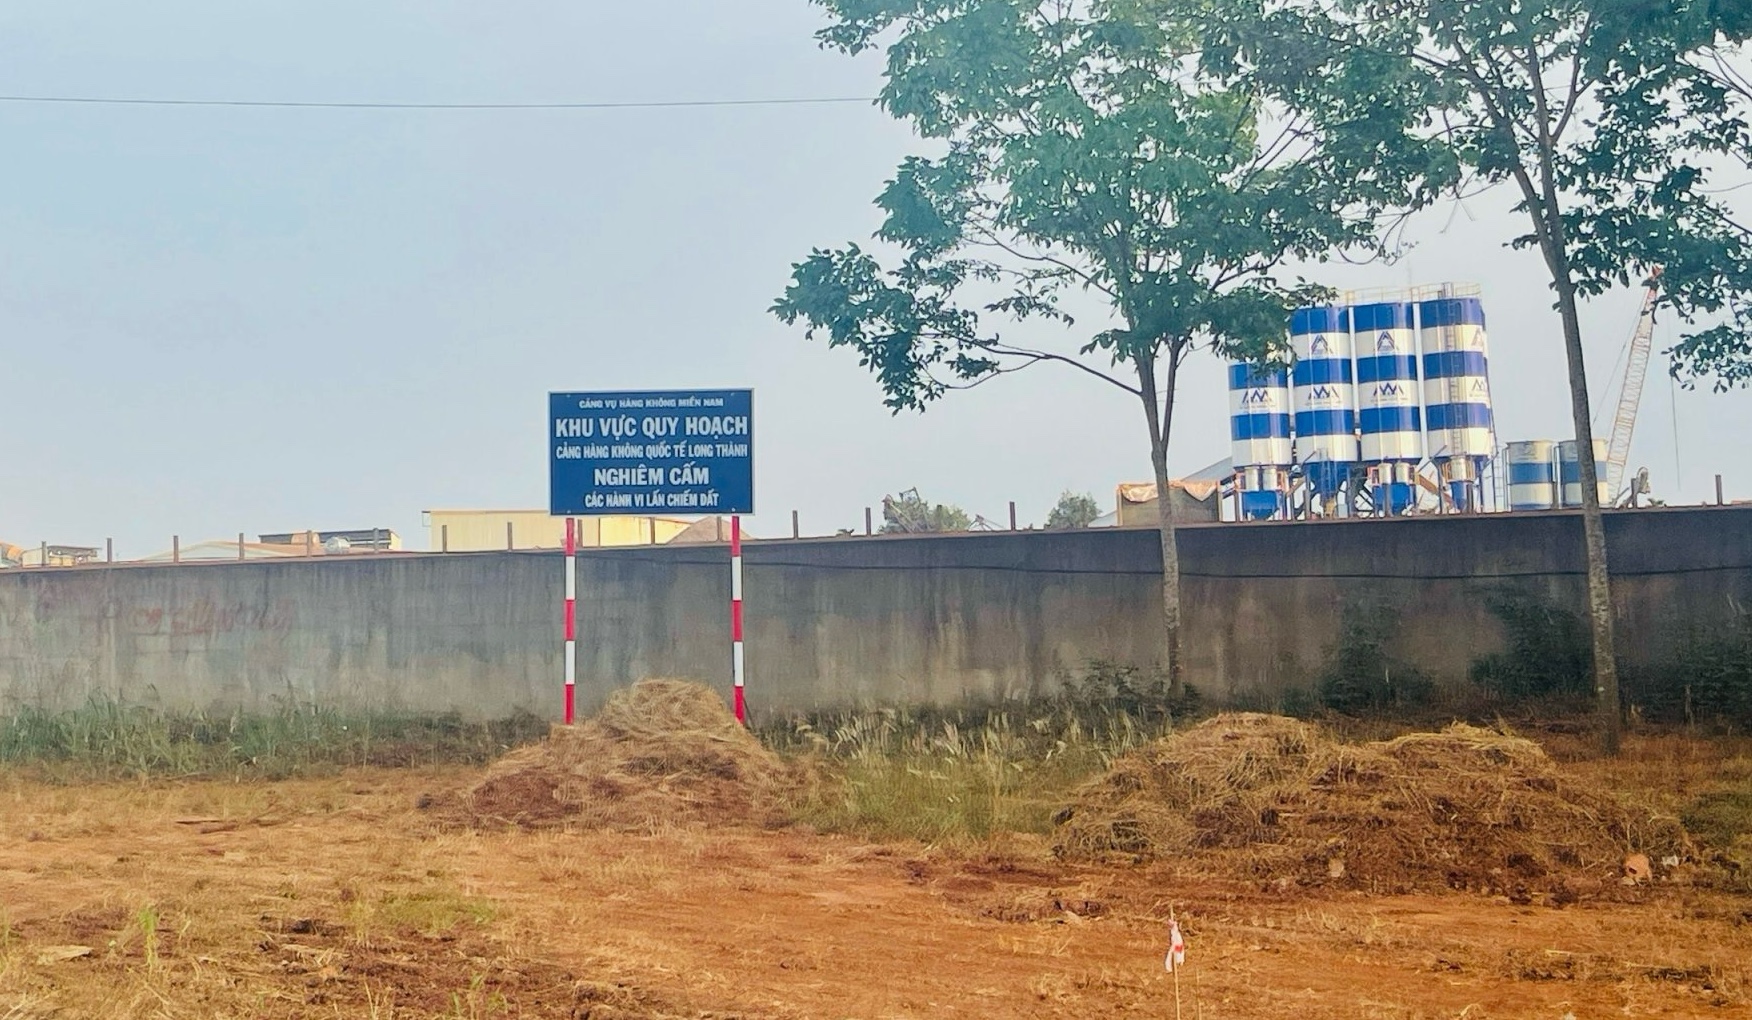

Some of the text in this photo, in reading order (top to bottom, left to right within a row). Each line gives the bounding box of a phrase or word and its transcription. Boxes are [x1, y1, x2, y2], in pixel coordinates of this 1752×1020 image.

[703, 398, 723, 406] NAM
[556, 414, 748, 441] KHU VỰC QUY HOẠCH
[556, 440, 748, 459] CẢNG HÀNG KHÔNG QUỐC TẾ LONG THÀNH
[594, 461, 709, 486] NGHIÊM CẤM
[585, 491, 604, 507] CÁC
[606, 491, 632, 507] HÀNH
[635, 494, 644, 507] VI
[667, 489, 698, 507] CHIẾM
